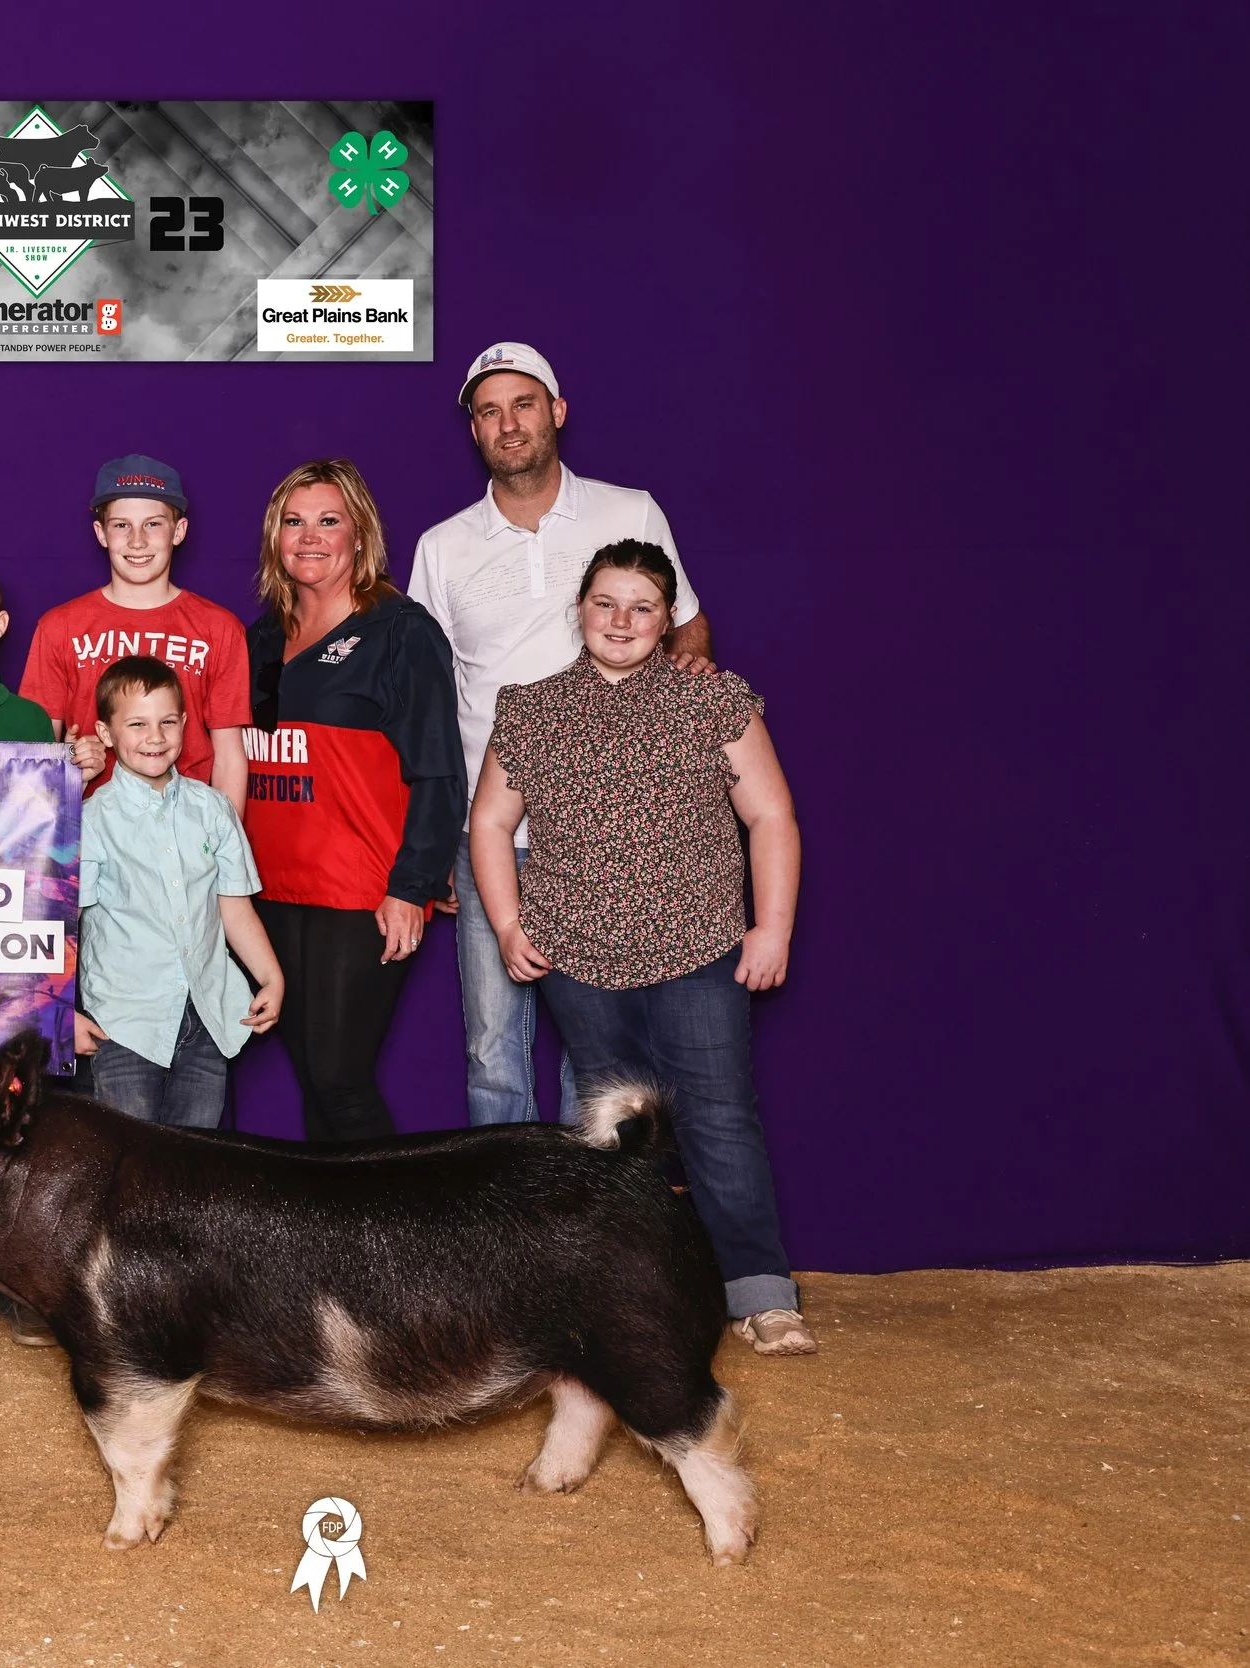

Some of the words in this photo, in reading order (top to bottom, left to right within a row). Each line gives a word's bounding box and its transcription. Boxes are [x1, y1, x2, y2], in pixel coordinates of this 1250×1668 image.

[55, 214, 131, 227] DISTRICT
[150, 196, 224, 251] 23
[262, 308, 308, 323] Great
[312, 308, 362, 323] Plains
[366, 308, 408, 323] Bank
[286, 334, 330, 344] Greater.
[334, 334, 384, 346] Together.
[117, 474, 166, 487] WINTER
[72, 630, 210, 669] WINTER
[78, 658, 202, 676] LIVOCK
